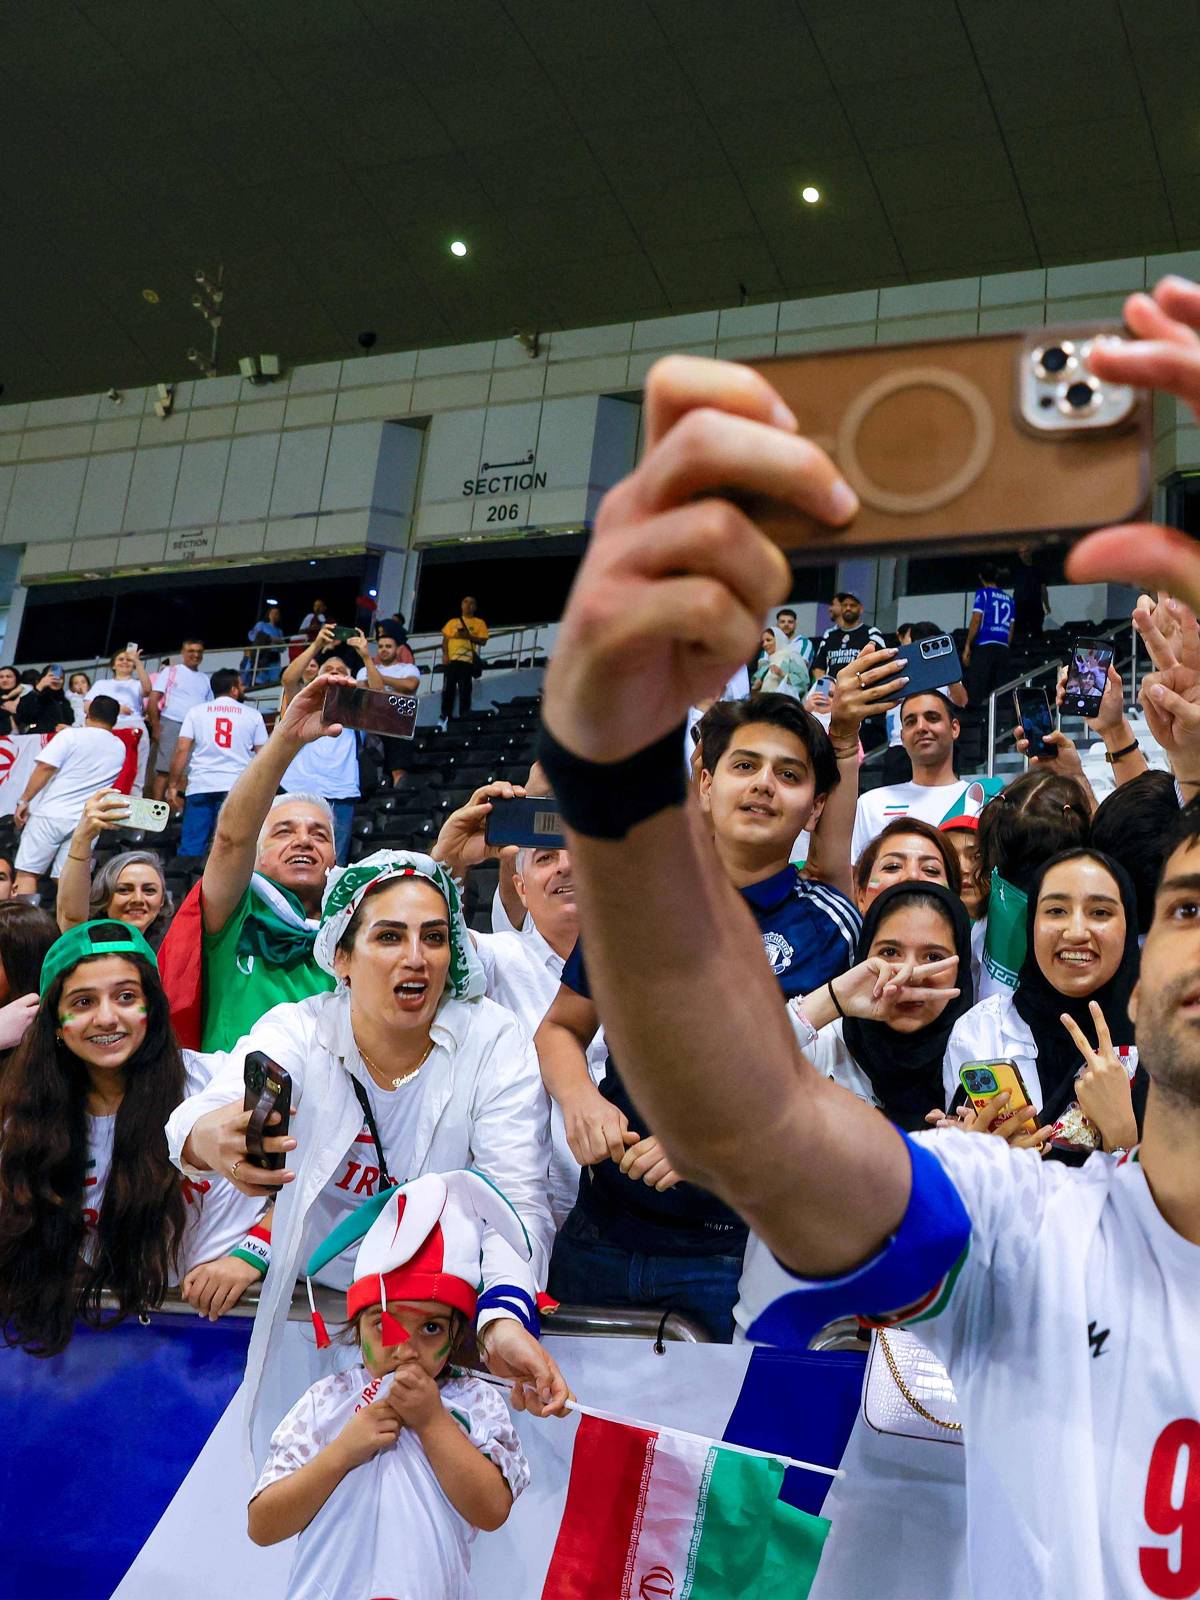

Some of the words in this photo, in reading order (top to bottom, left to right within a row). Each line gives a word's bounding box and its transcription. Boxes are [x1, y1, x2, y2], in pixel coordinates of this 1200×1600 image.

[462, 472, 547, 496] SECTION
[486, 504, 519, 522] 206
[173, 537, 208, 550] SECTION
[992, 600, 1011, 627] 12
[214, 717, 233, 749] 8
[334, 1160, 400, 1197] IR
[243, 1241, 268, 1257] IRAN
[361, 1377, 383, 1405] IRA
